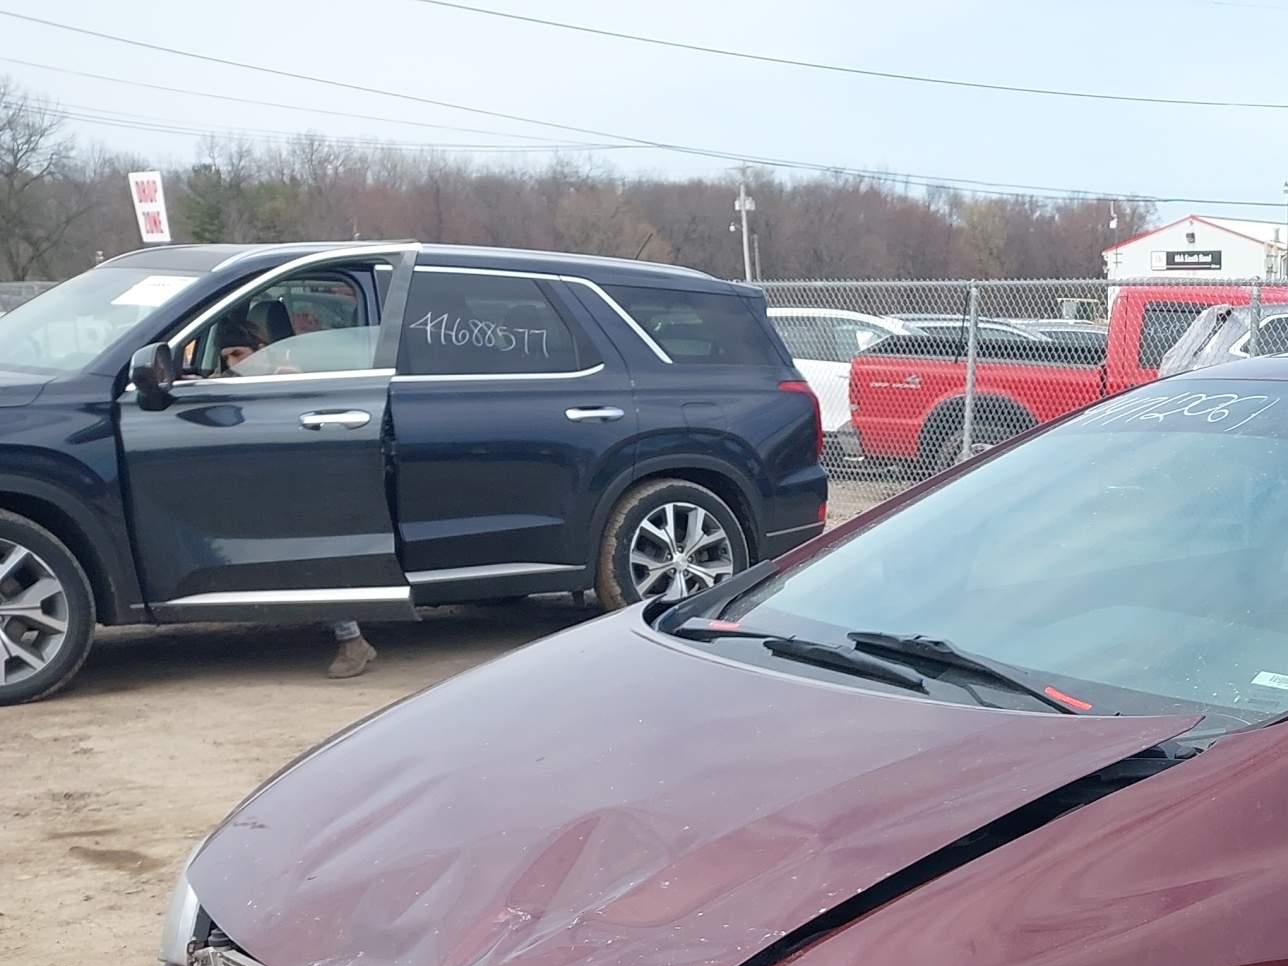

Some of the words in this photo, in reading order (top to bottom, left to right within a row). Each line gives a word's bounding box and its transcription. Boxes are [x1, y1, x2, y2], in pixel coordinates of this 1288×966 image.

[135, 180, 157, 203] DROP
[143, 211, 163, 234] ZONE
[409, 311, 549, 358] 44688577
